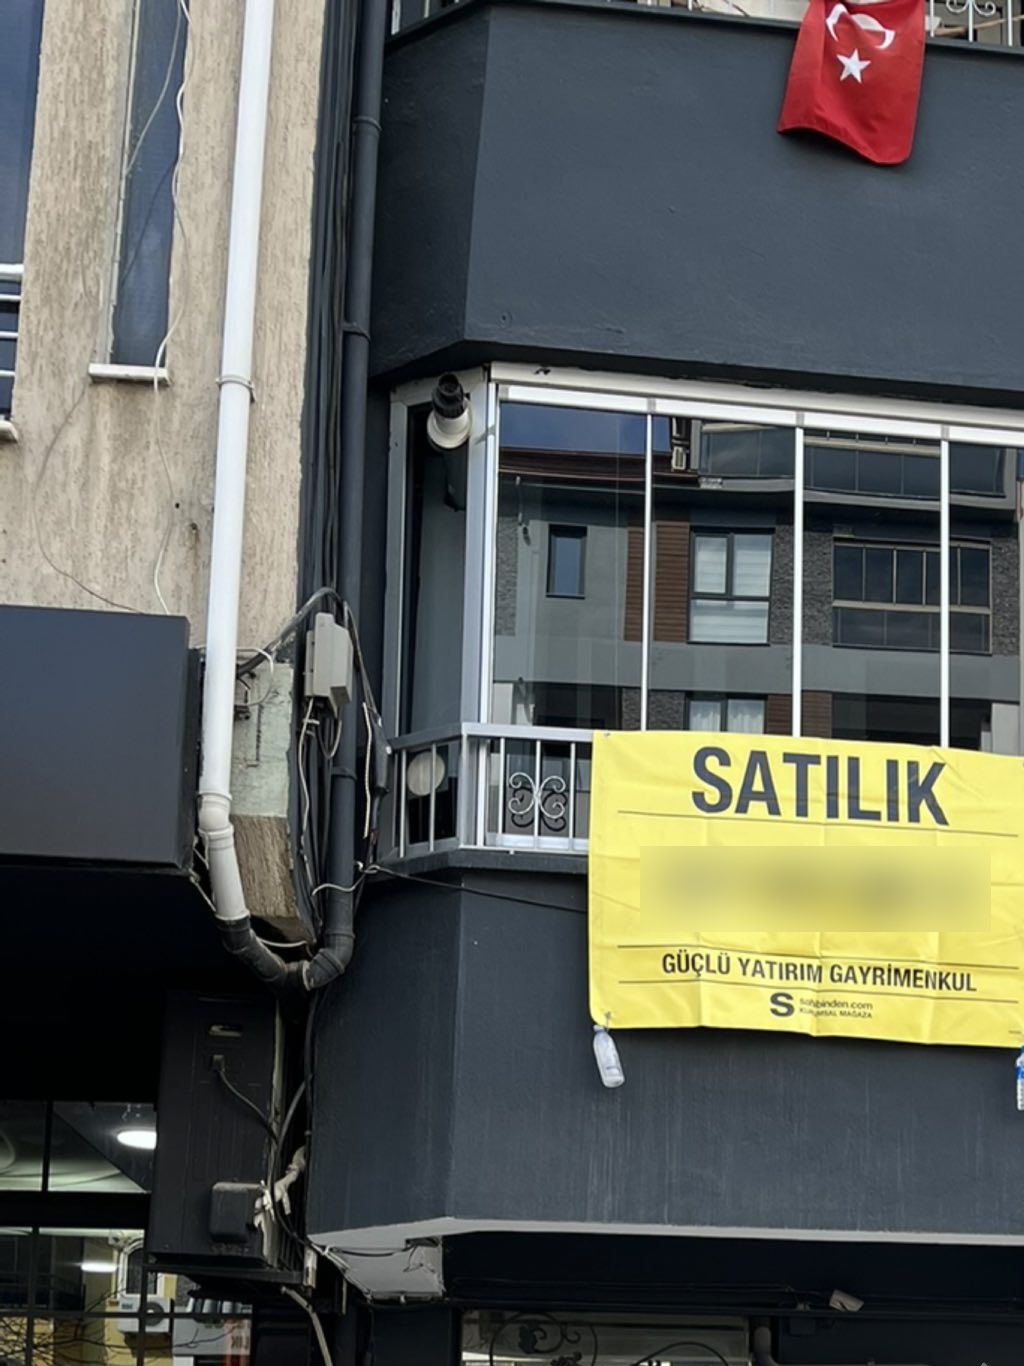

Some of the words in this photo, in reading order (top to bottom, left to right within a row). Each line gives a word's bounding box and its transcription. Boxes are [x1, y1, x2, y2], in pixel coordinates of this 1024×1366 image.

[692, 746, 949, 825] SATILIK
[662, 949, 730, 977] GÜÇLÜ
[738, 957, 823, 983] YATIRIM
[830, 964, 977, 991] GAYRİMENKUL
[799, 998, 873, 1010] sahbinden.com
